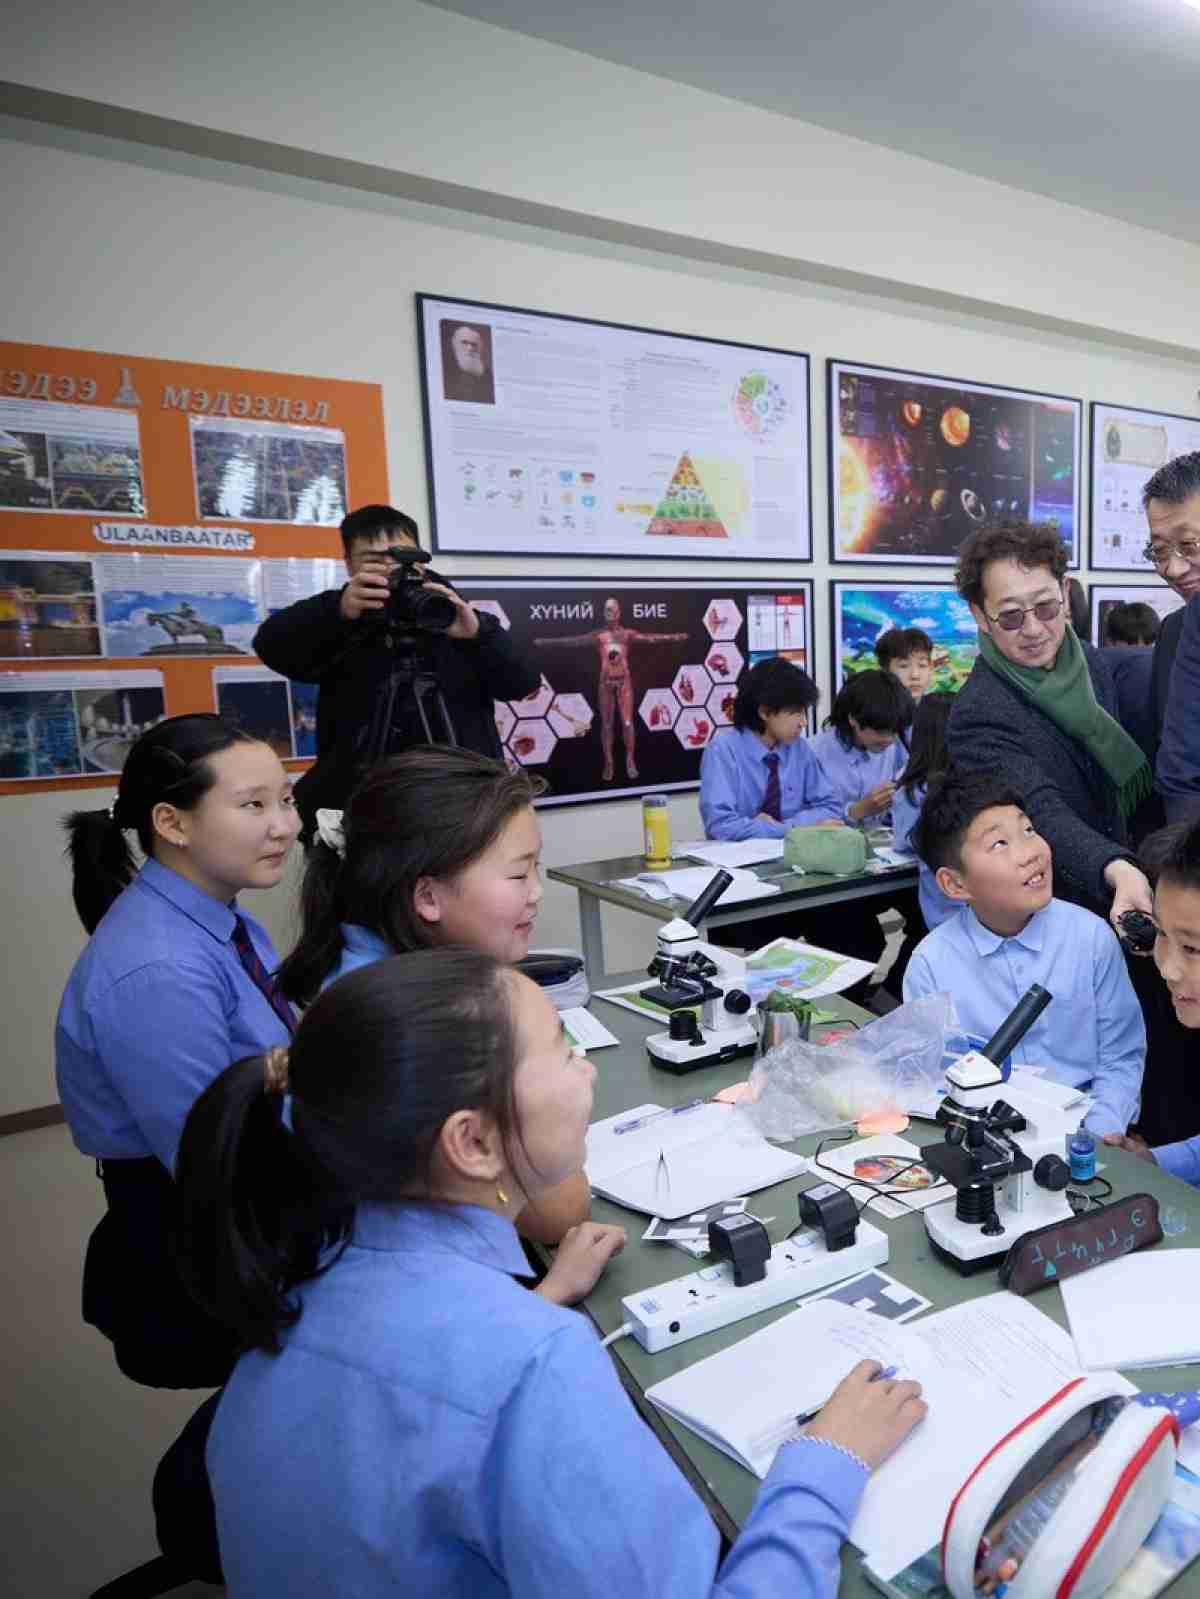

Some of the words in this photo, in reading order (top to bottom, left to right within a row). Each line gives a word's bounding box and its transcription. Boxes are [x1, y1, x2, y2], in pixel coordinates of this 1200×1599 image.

[0, 369, 97, 400] ЭДЭЭ
[161, 384, 331, 422] МЭДЭЭЛЭЛ
[97, 523, 254, 547] ULAANBAATAR
[530, 600, 593, 619] ХҮНИЙ
[632, 603, 667, 619] БИЕ
